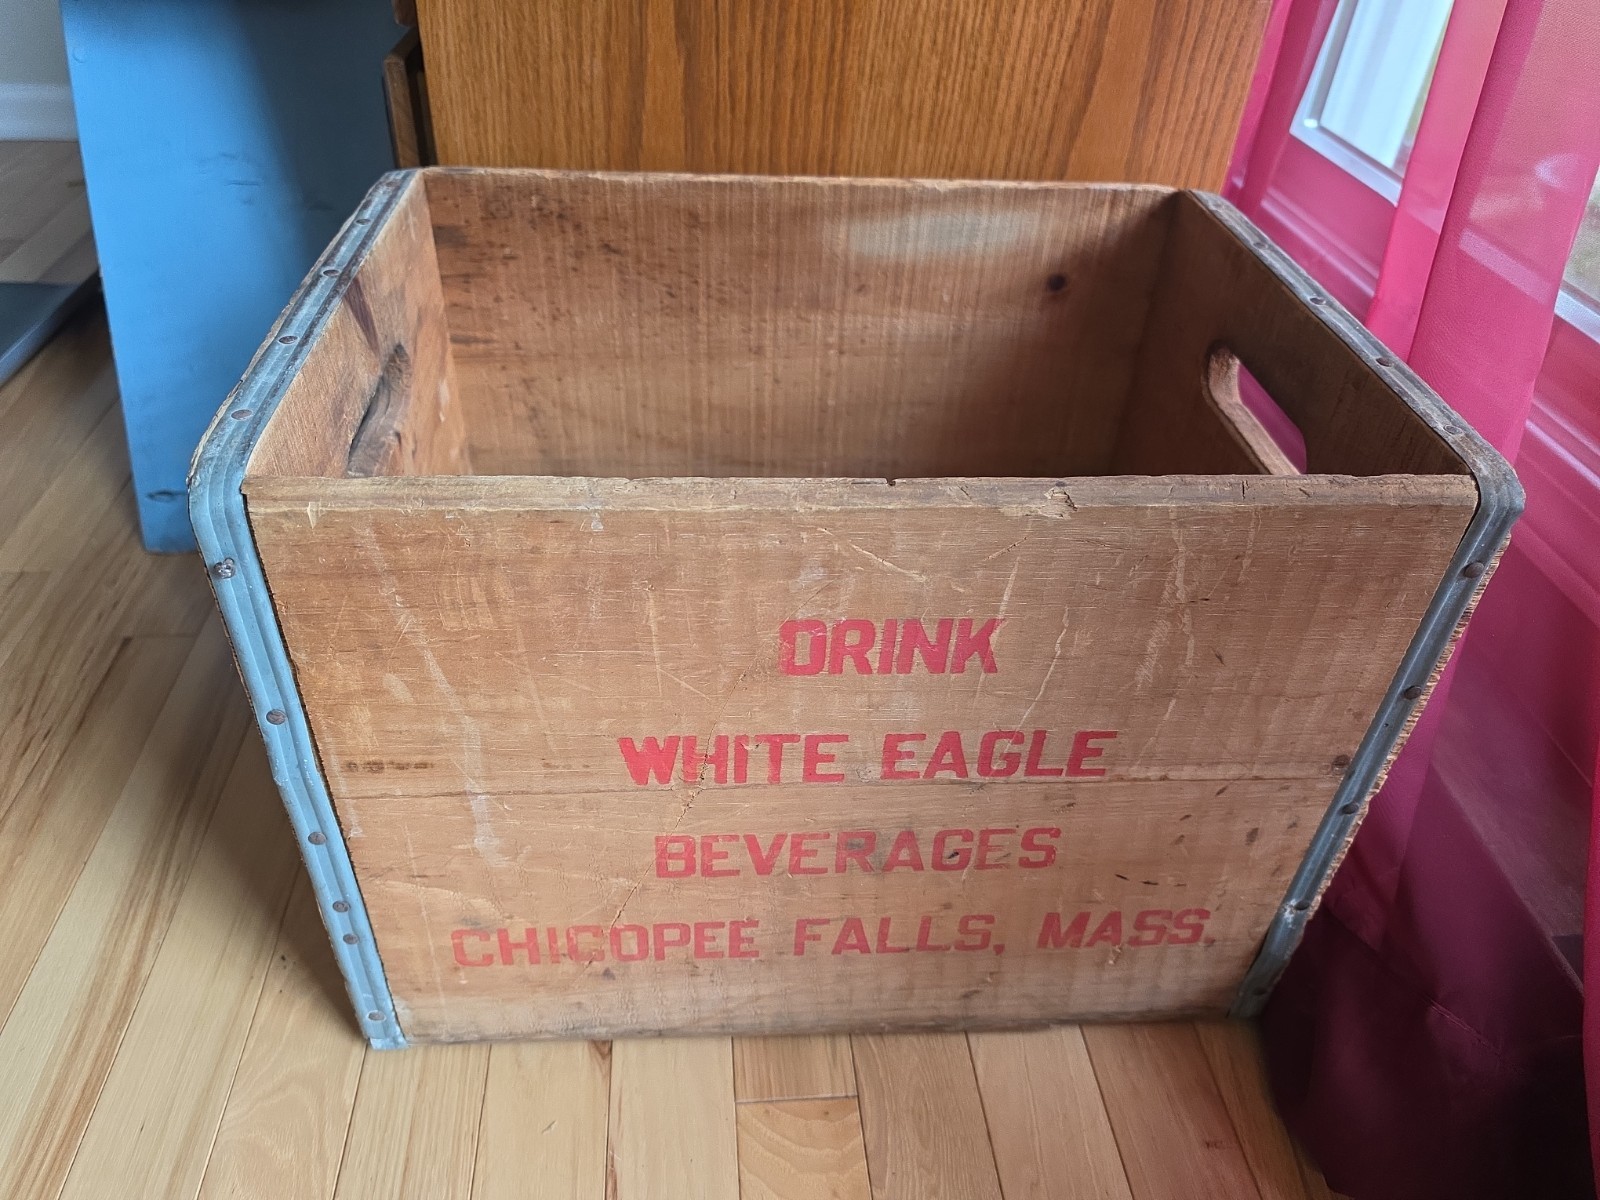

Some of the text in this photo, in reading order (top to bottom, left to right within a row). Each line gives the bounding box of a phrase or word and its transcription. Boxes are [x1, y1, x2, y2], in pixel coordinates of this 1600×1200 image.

[778, 618, 1006, 676] DRINK
[618, 729, 1118, 786] WHITE EAGLE
[655, 826, 1062, 878] BEVERAGES
[451, 918, 760, 968] CHICOPEE
[794, 914, 1005, 956] FALLS,
